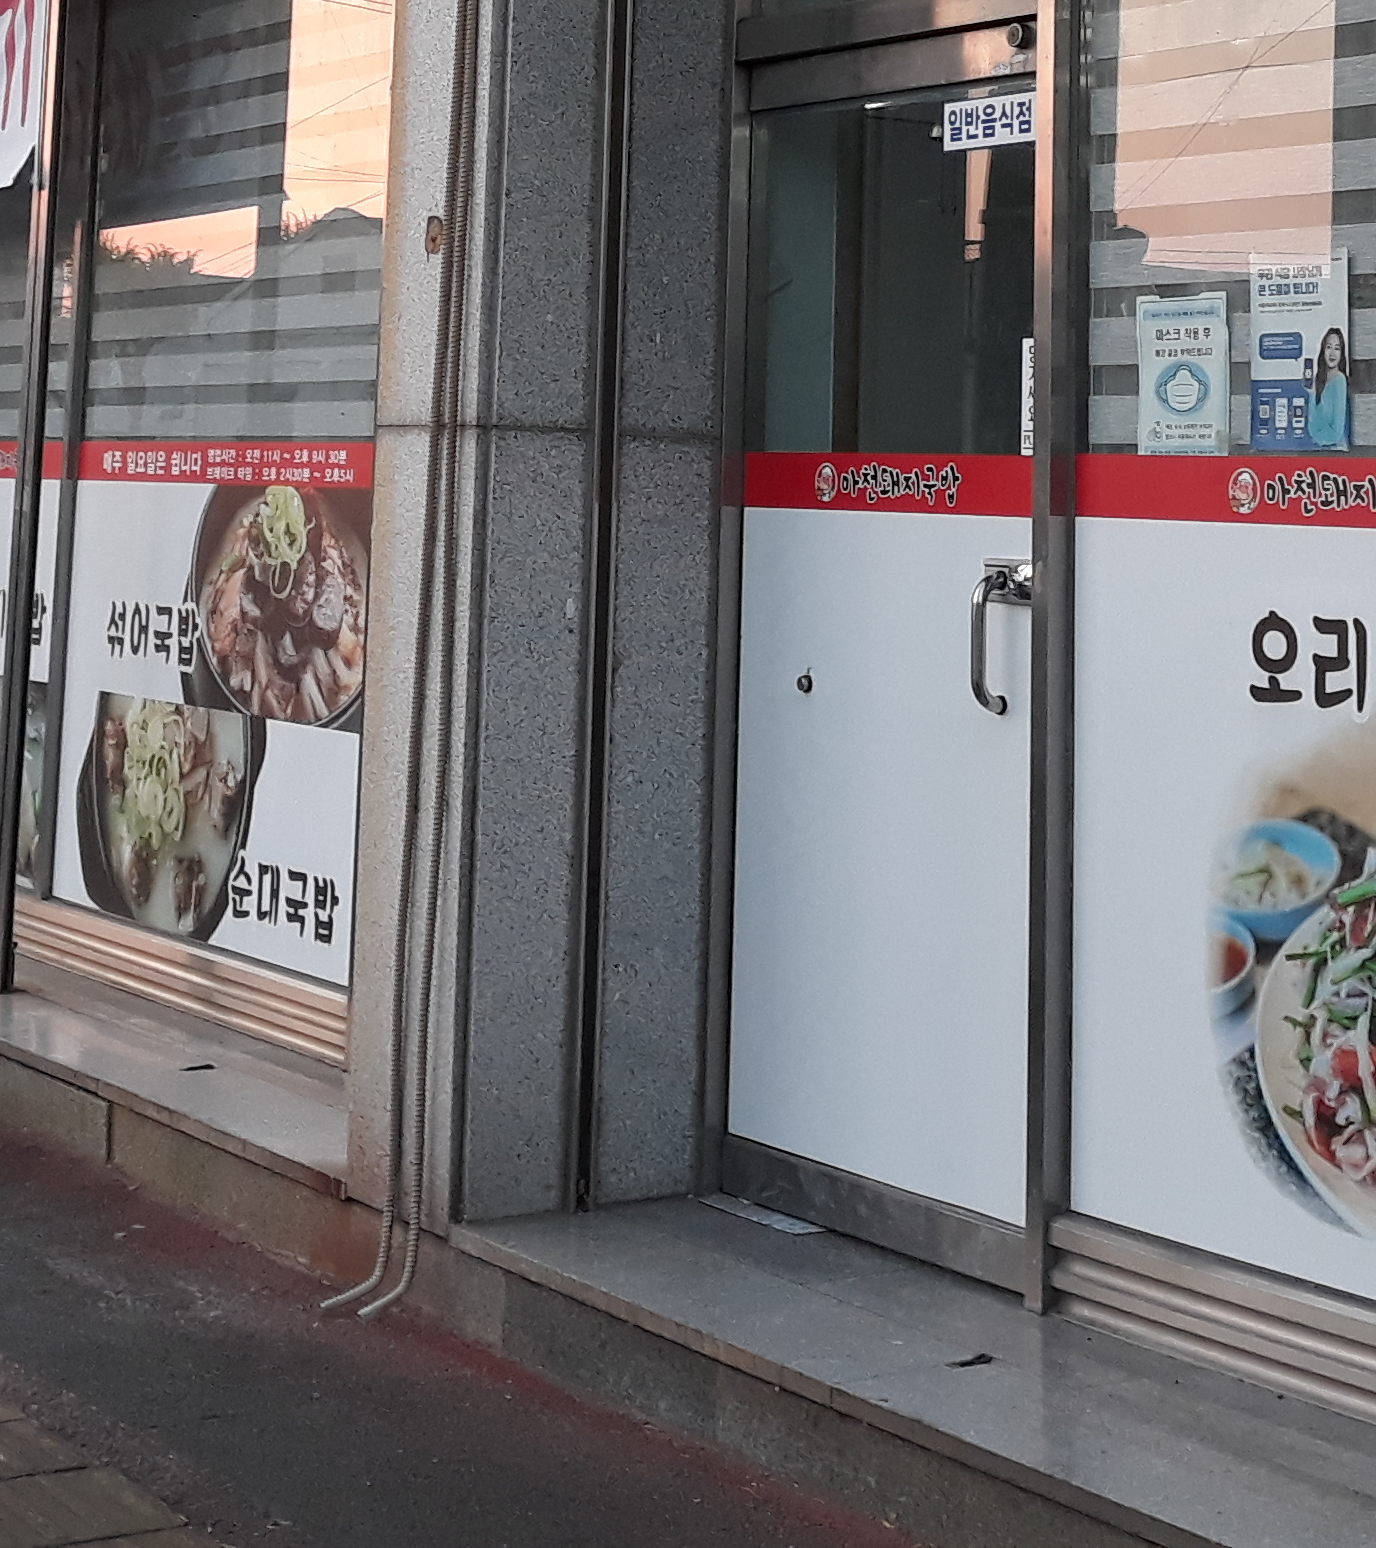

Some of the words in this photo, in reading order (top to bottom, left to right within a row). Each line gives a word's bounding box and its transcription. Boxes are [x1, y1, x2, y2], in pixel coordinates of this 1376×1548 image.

[947, 98, 1033, 143] 일반음식점
[126, 450, 167, 475] 일요일은
[170, 450, 202, 476] 쉽니다
[839, 462, 962, 508] 마천돼지국밥
[106, 600, 199, 668] 섞어국밥
[230, 855, 340, 945] 순대국밥
